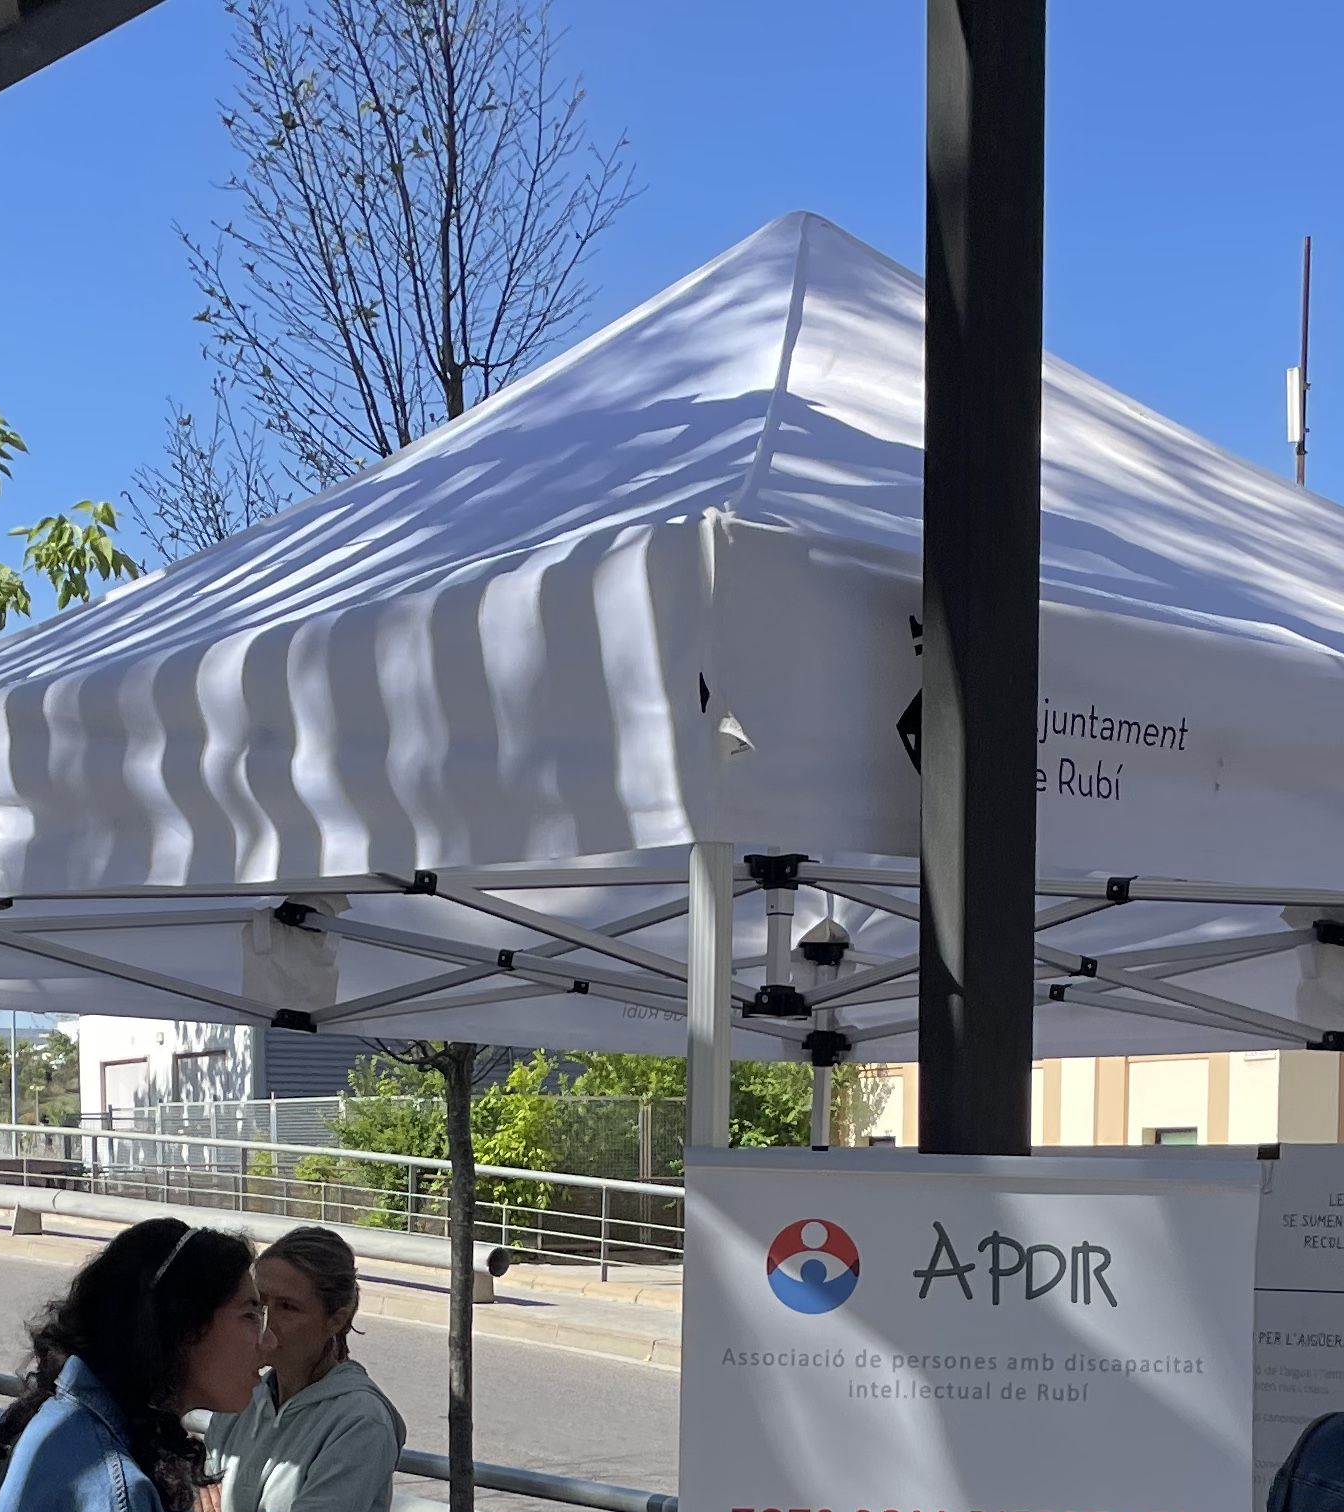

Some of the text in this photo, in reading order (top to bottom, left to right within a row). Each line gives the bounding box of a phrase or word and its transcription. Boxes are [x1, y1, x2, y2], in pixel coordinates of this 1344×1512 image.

[1036, 698, 1189, 750] juntament
[1036, 757, 1124, 801] e Rubí
[1282, 1214, 1298, 1228] SE
[1302, 1214, 1343, 1229] SUMEN
[913, 1221, 1117, 1308] APDIR
[1258, 1331, 1281, 1345] PER
[721, 1347, 1204, 1380] Associació de persones amb discapacitat
[1000, 1381, 1027, 1401] de
[1037, 1382, 1089, 1403] Rubí
